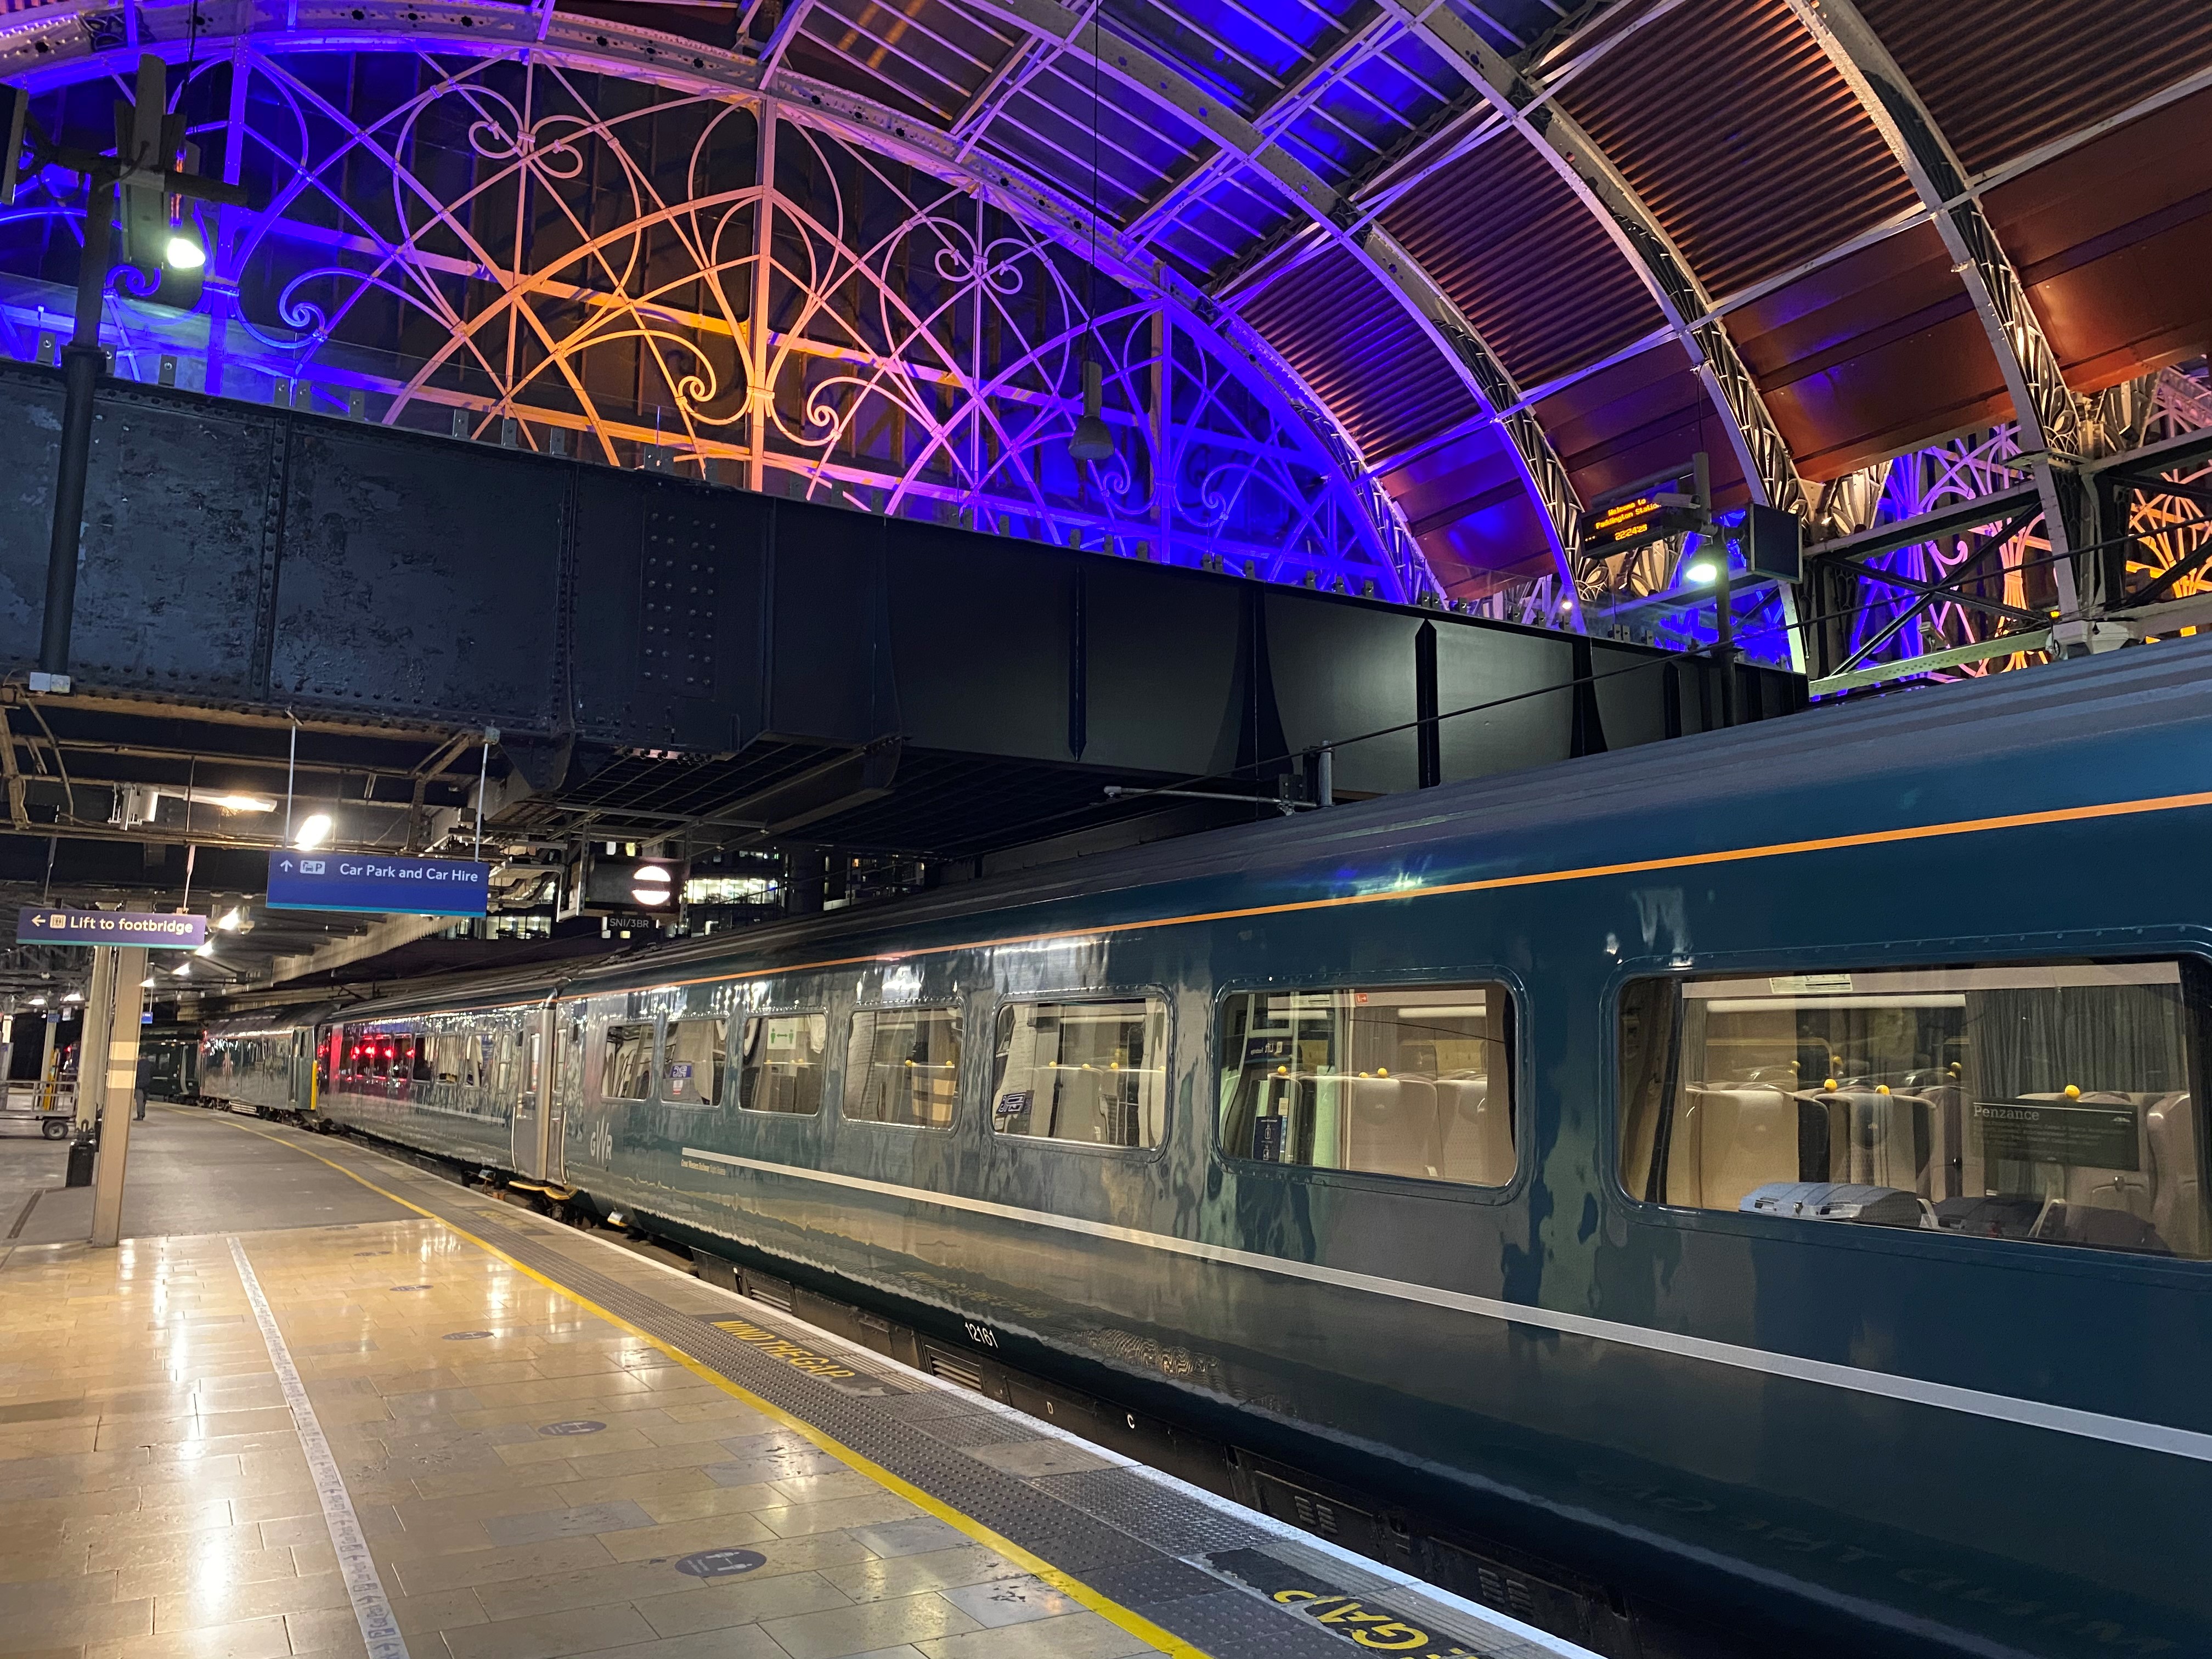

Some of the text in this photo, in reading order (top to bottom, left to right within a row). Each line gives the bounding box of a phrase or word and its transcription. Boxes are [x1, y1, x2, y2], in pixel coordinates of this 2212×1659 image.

[1596, 512, 1633, 529] Paddington
[340, 863, 363, 876] Car
[366, 865, 395, 878] Park
[399, 867, 422, 879] and
[426, 868, 448, 881] Car
[452, 870, 478, 882] Hire
[70, 916, 193, 935] Lift to footbridge
[1973, 1105, 2040, 1121] Penzance
[590, 1115, 613, 1166] GWR
[965, 1322, 998, 1348] 12161
[710, 1320, 856, 1378] MIND THE GAP
[1047, 1401, 1054, 1415] D
[1127, 1414, 1135, 1429] C
[1273, 1590, 1429, 1650] GAP
